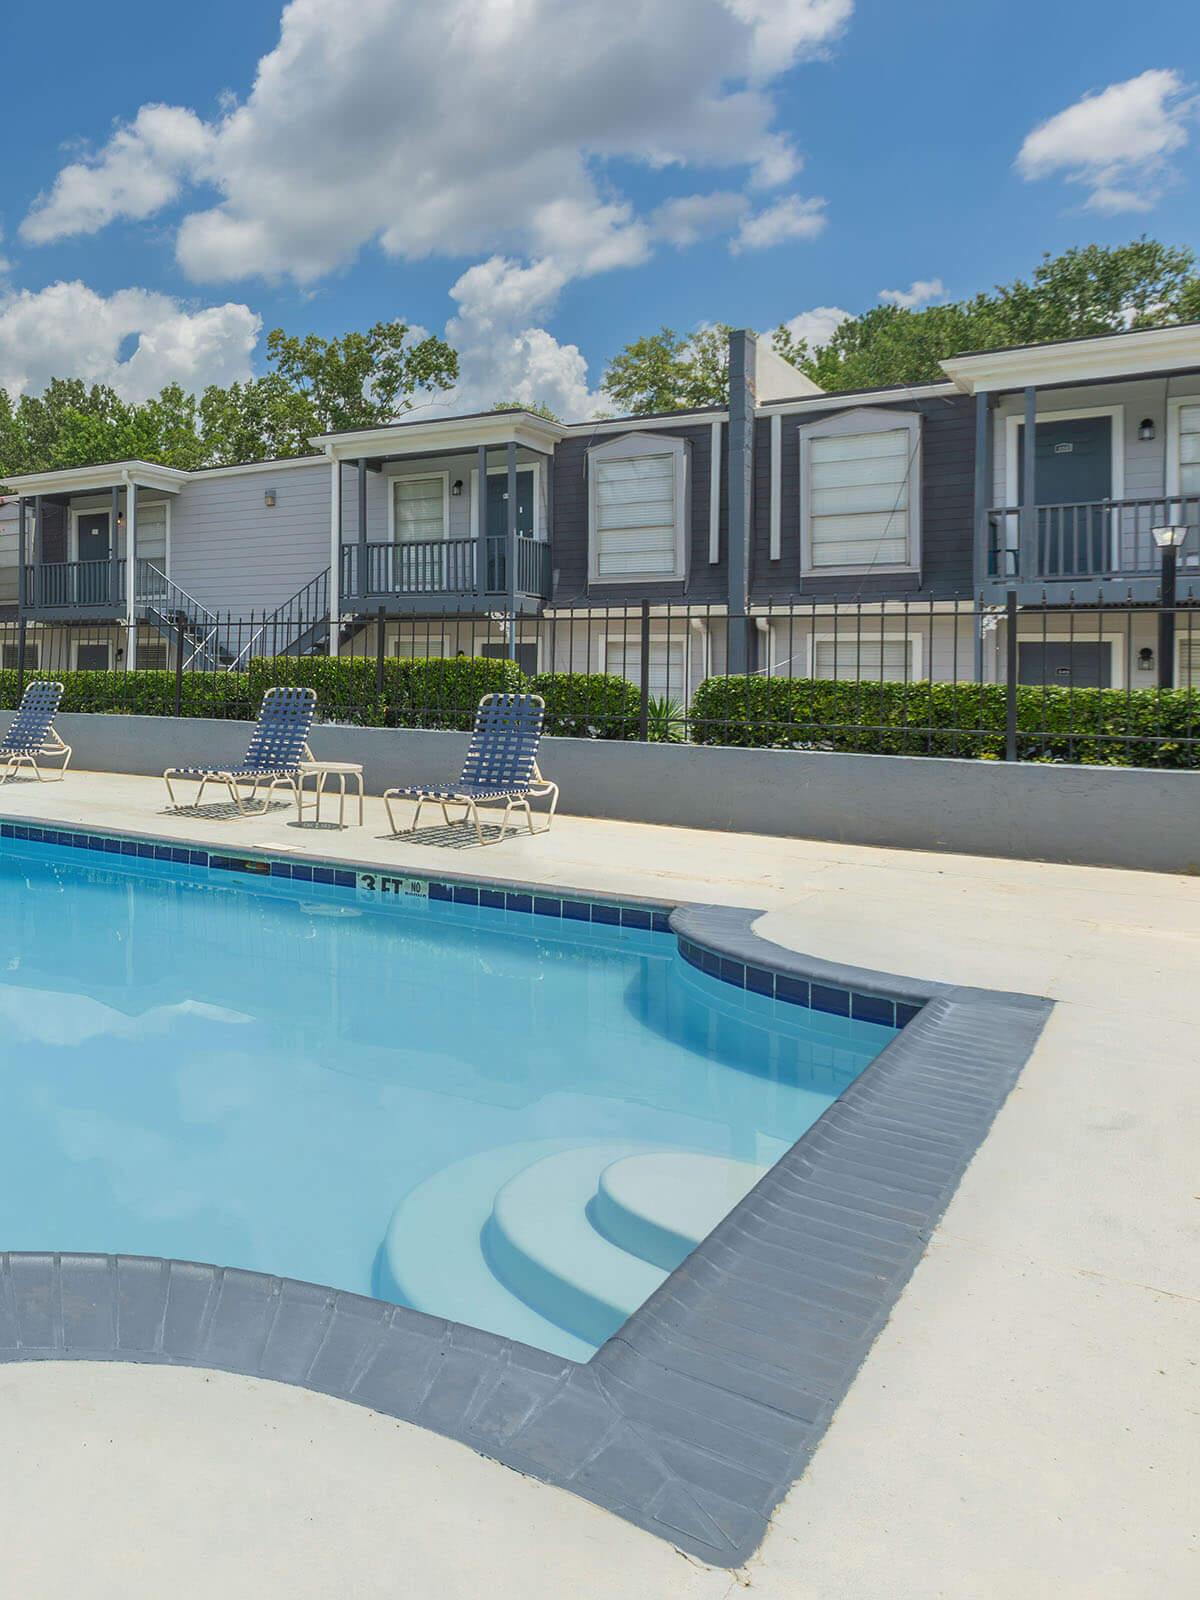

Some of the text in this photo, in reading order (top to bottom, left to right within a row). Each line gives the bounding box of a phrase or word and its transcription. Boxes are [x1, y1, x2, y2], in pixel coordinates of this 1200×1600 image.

[361, 874, 403, 894] 3 FT
[411, 882, 421, 893] NO
